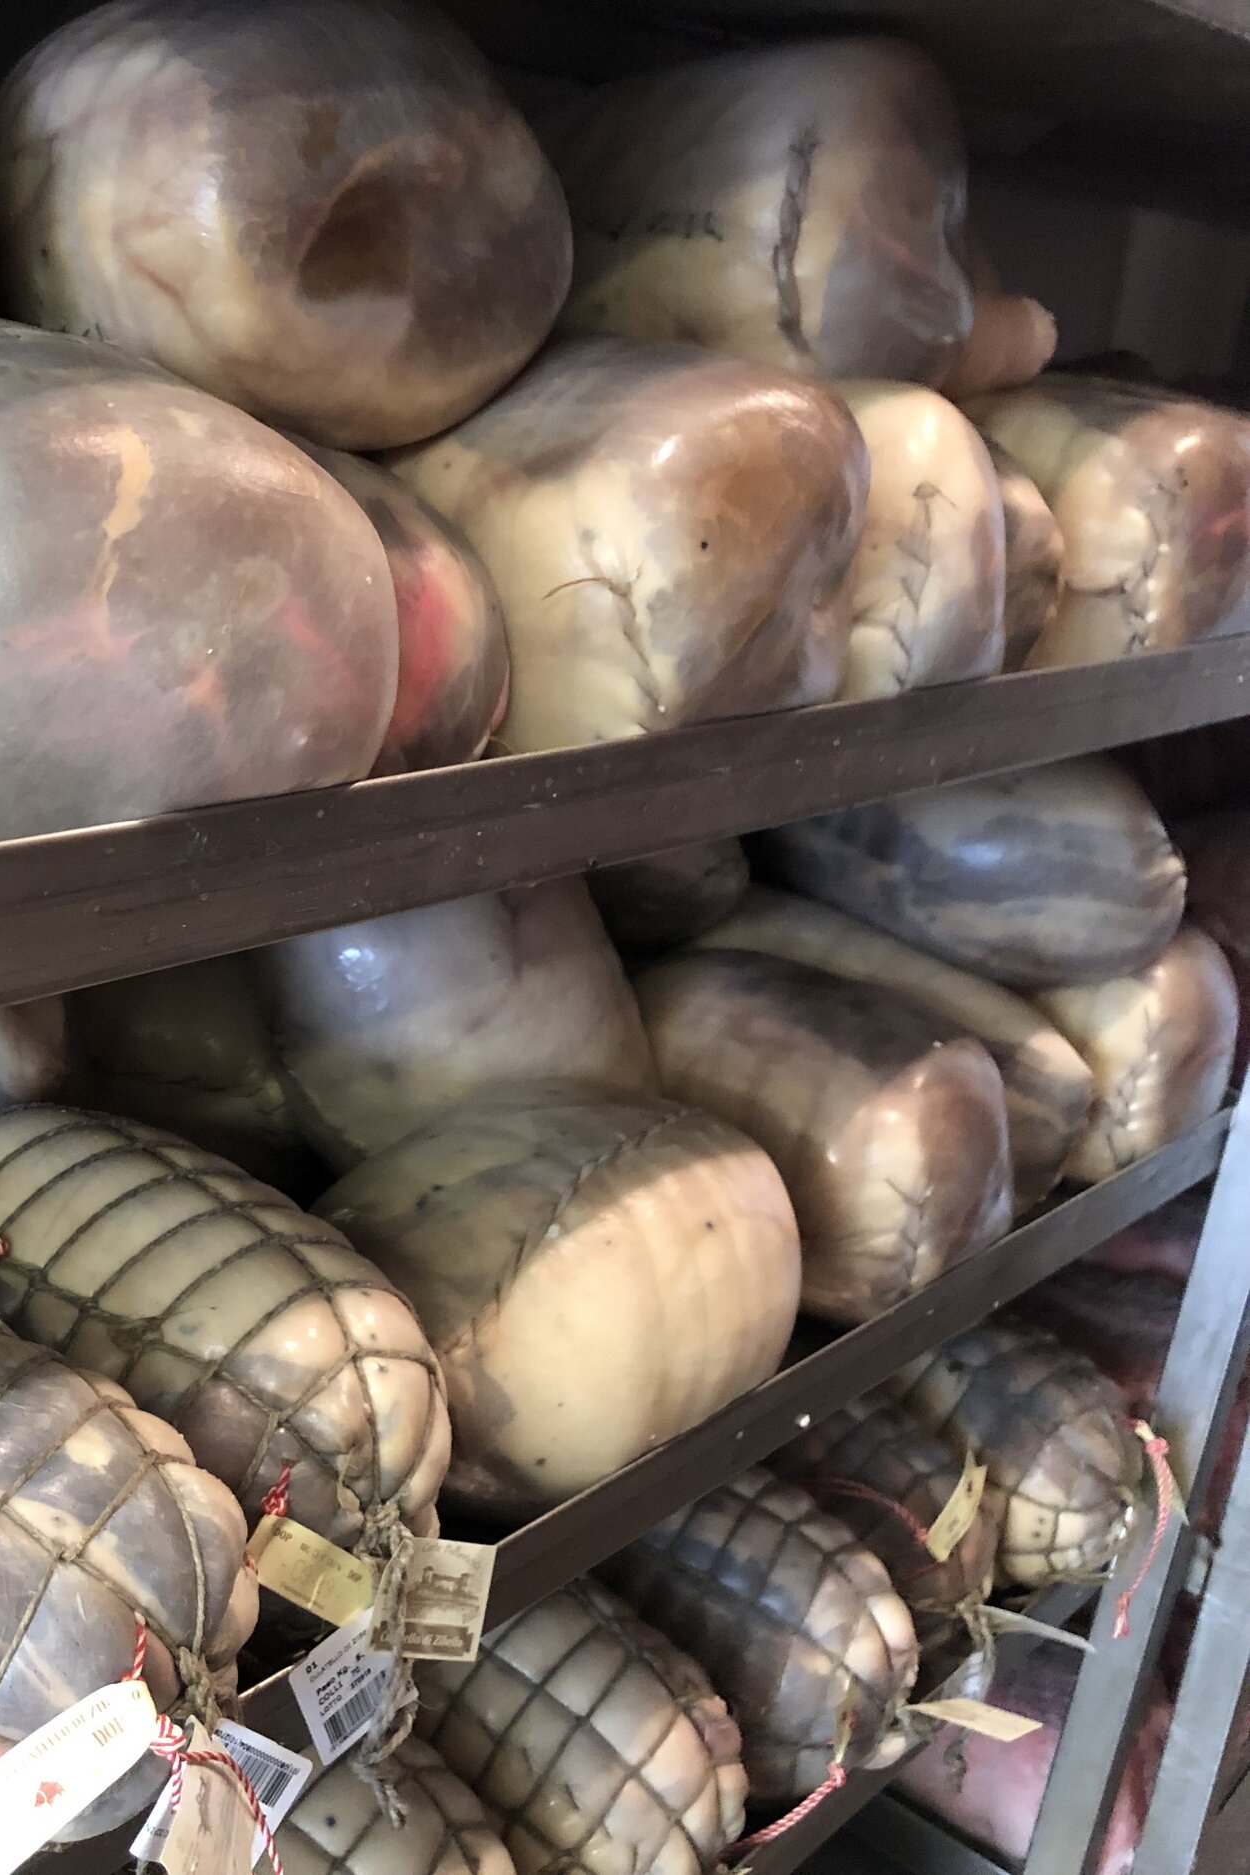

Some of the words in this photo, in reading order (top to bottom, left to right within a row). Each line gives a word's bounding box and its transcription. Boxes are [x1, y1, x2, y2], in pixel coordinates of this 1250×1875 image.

[274, 1526, 294, 1543] DOP
[318, 1681, 344, 1706] COLLI
[320, 1694, 343, 1717] LOTTO
